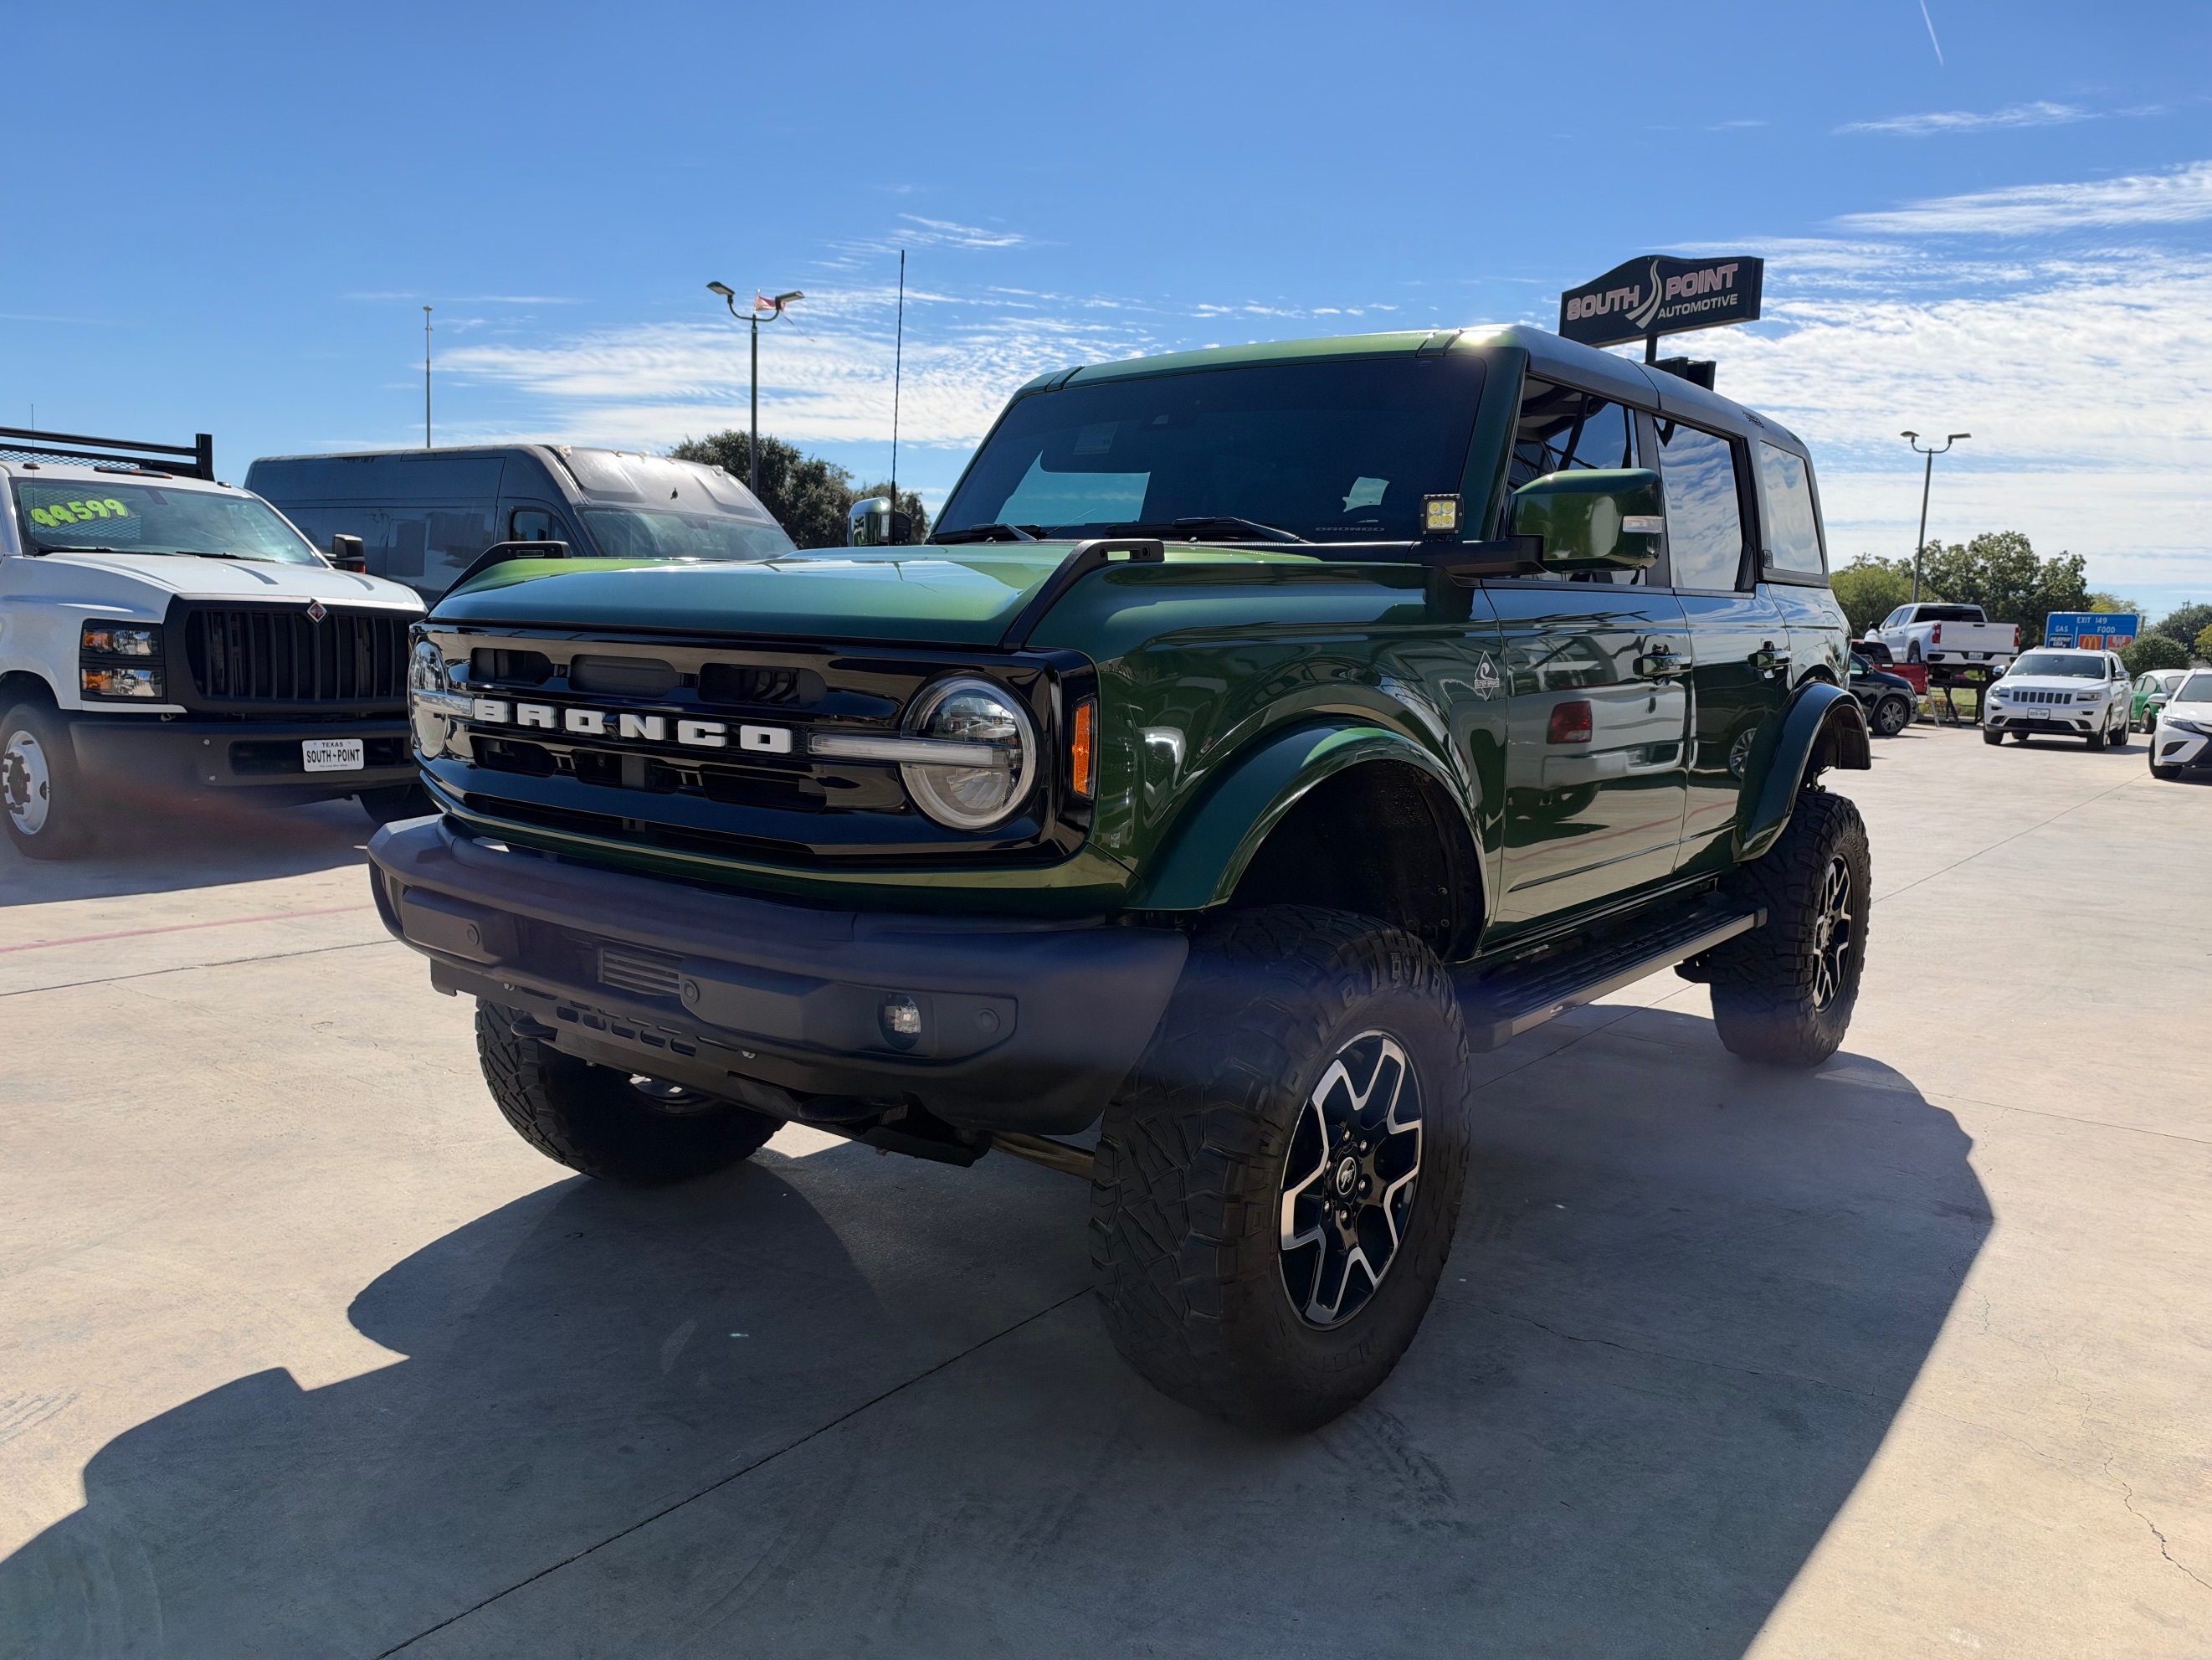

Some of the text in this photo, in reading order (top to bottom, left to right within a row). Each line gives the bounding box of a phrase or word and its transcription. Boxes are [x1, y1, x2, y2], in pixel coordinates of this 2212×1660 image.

[1567, 263, 1738, 321] SOUTH POINT
[1657, 294, 1737, 320] AUTOMOTIVE
[31, 499, 128, 527] 44599
[2097, 625, 2116, 634] FOOD
[474, 698, 793, 753] BRONCO
[306, 748, 360, 763] SOUTH POINT
